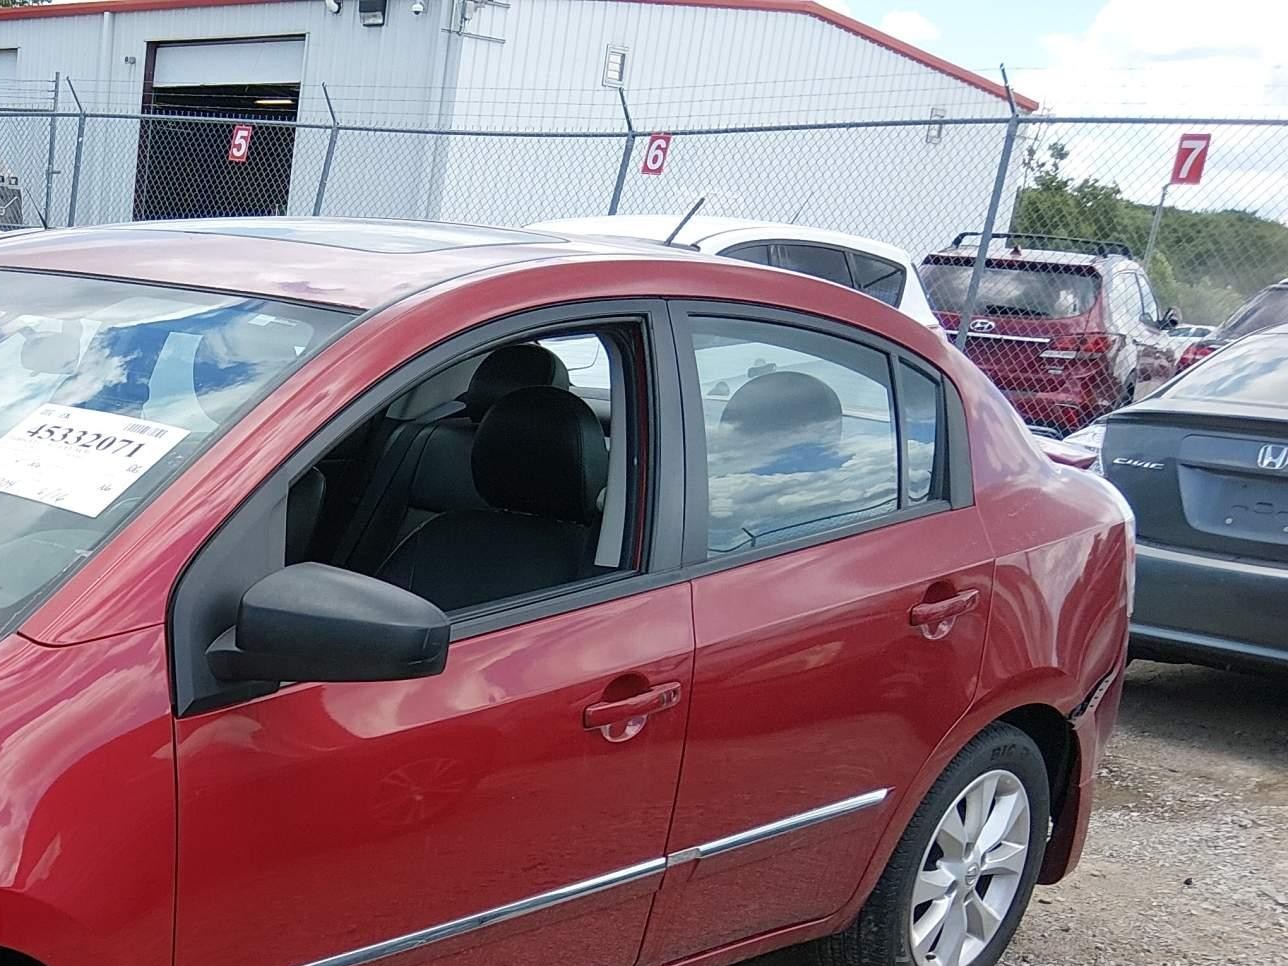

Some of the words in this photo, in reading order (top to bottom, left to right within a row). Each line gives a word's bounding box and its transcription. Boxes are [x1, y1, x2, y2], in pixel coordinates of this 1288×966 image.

[232, 130, 249, 157] 5
[646, 138, 667, 170] 6
[1178, 139, 1208, 179] 7
[26, 423, 146, 458] 45332071
[1112, 457, 1165, 470] CIVIC
